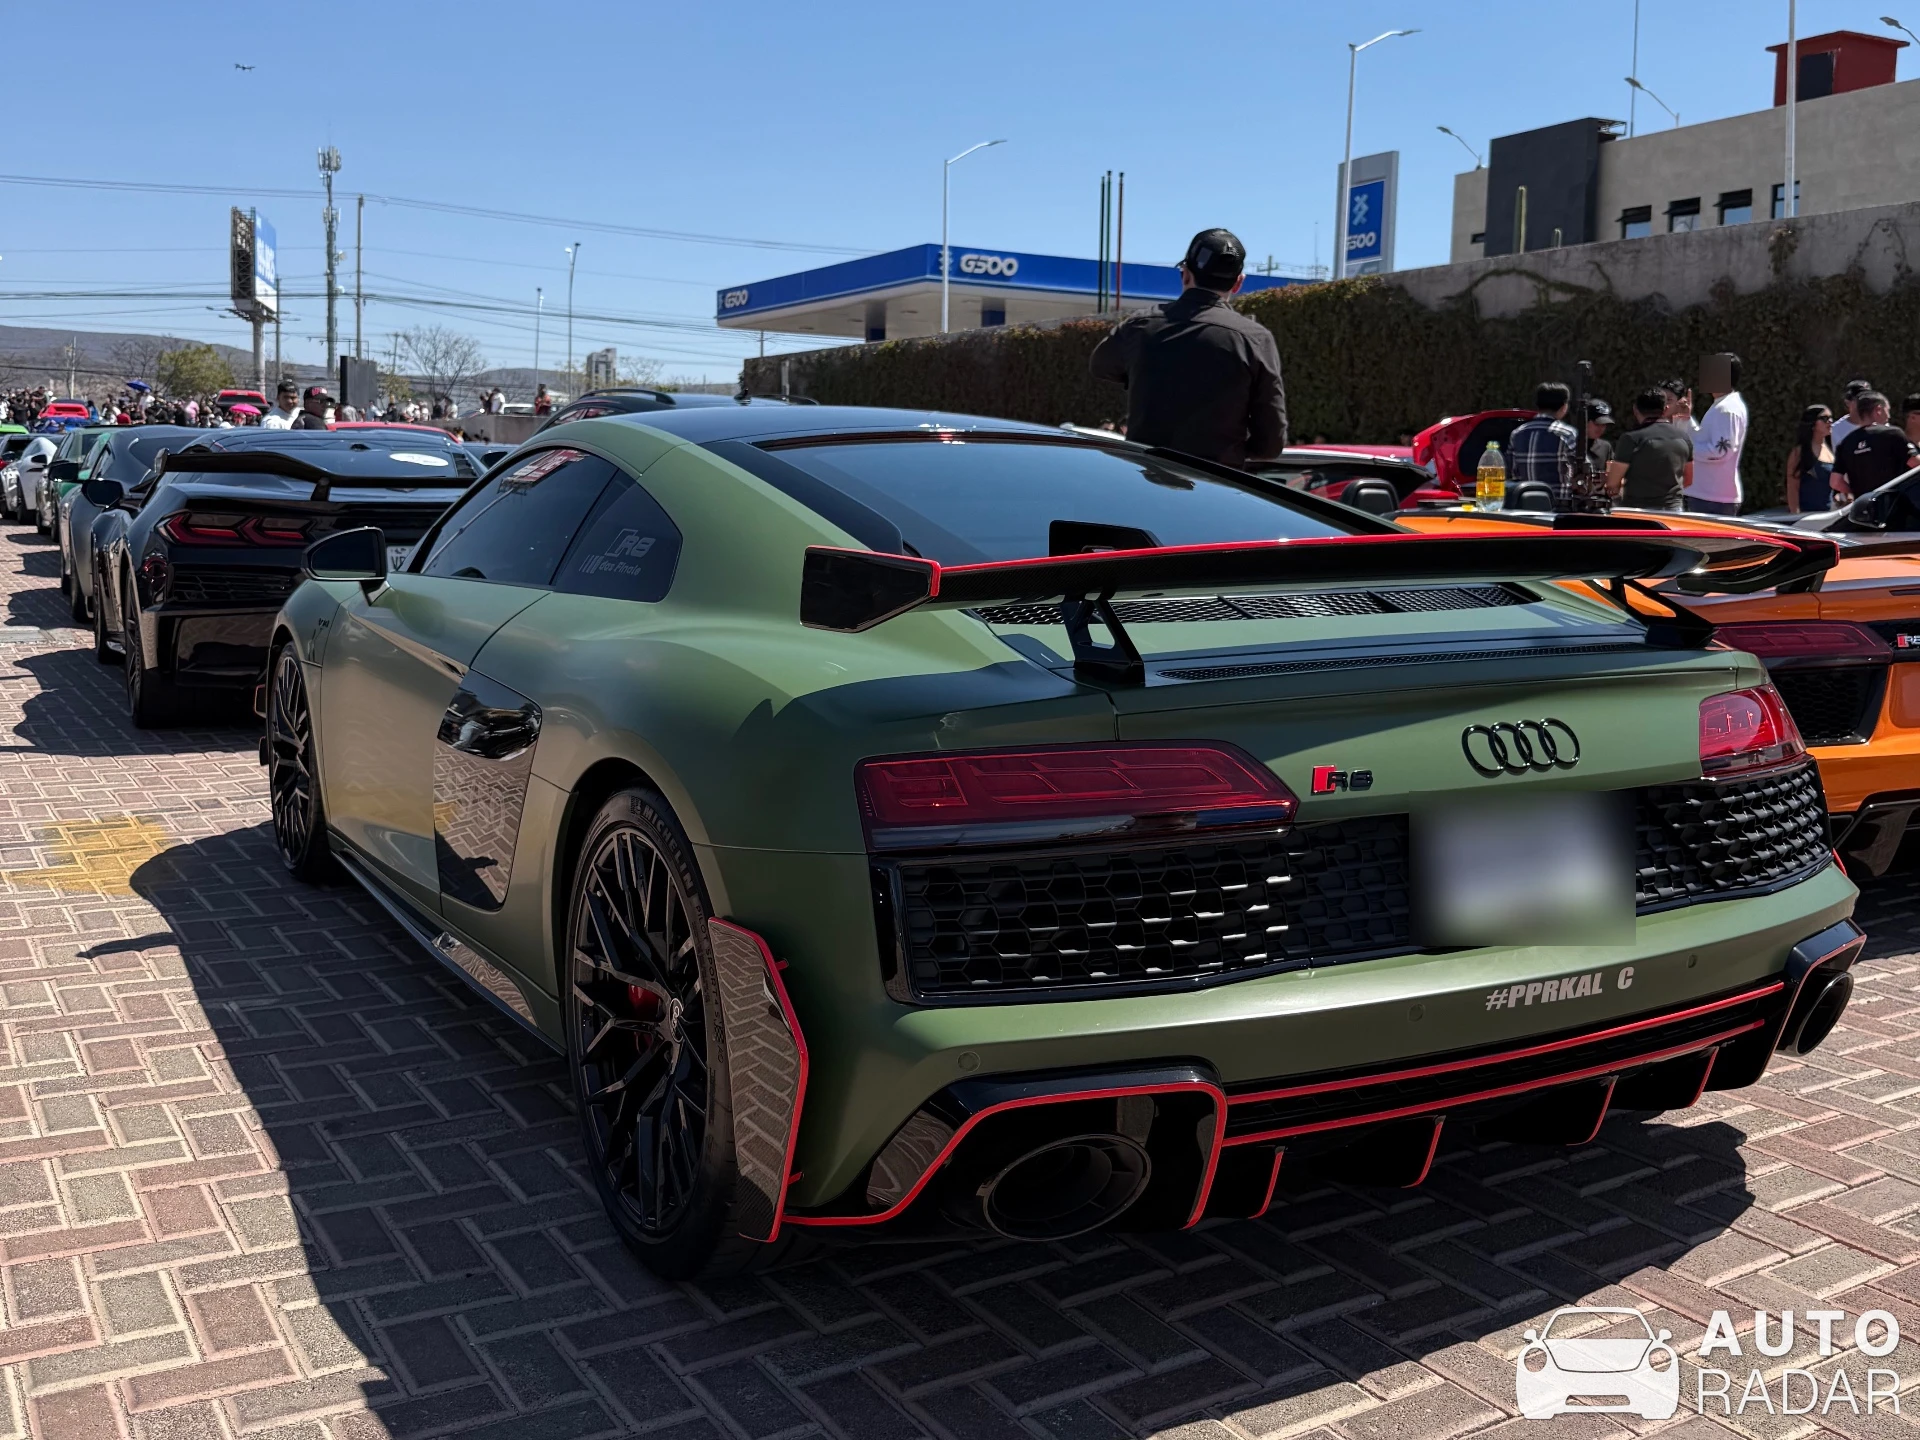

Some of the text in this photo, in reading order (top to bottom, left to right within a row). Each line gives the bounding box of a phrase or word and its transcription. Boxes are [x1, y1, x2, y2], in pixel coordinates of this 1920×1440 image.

[960, 254, 1019, 277] G500
[724, 289, 749, 309] G500
[609, 531, 656, 558] R8
[1318, 766, 1373, 794] R8
[643, 804, 694, 892] MICHELIN
[695, 905, 709, 940] PILOT
[705, 948, 718, 997] SPORT
[1485, 966, 1635, 1011] #PPRKAL C
